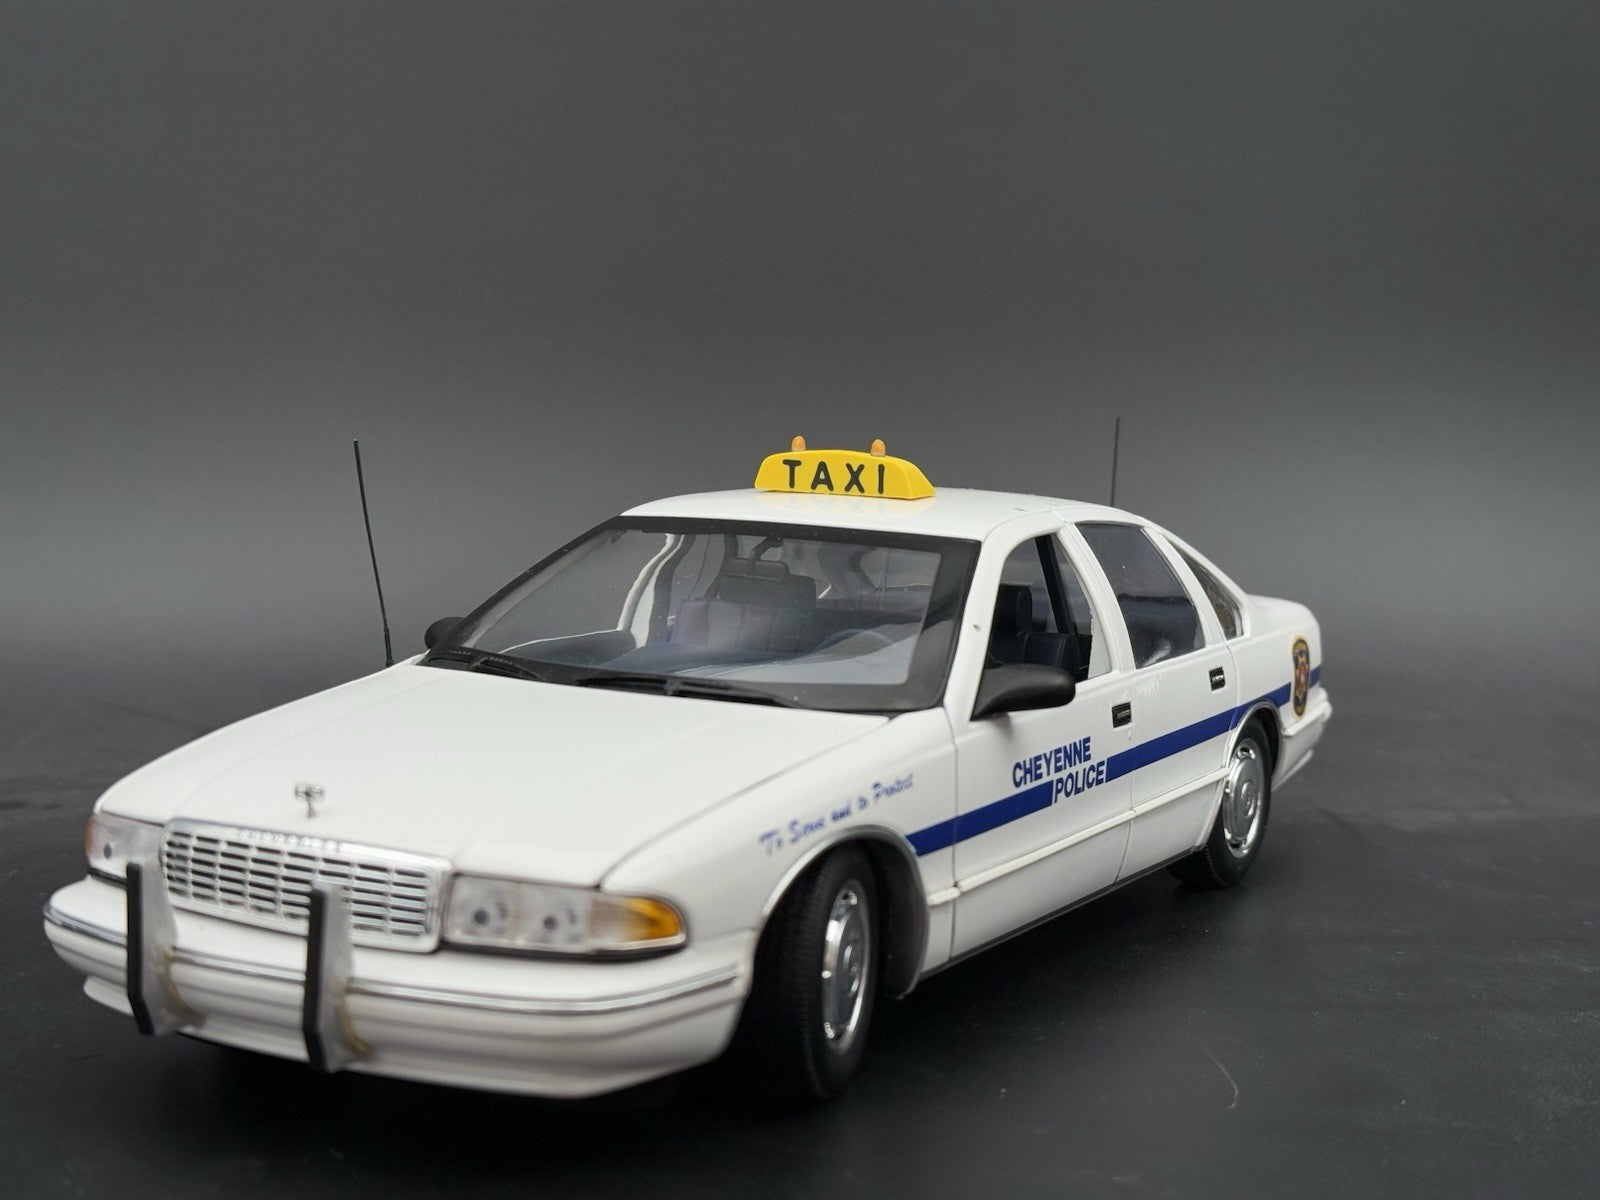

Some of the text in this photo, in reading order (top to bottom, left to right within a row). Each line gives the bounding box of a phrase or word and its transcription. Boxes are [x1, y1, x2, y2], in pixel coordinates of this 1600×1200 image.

[782, 459, 885, 494] TAXI
[1012, 736, 1092, 788] CHEYENNE
[1054, 760, 1105, 803] POLICE
